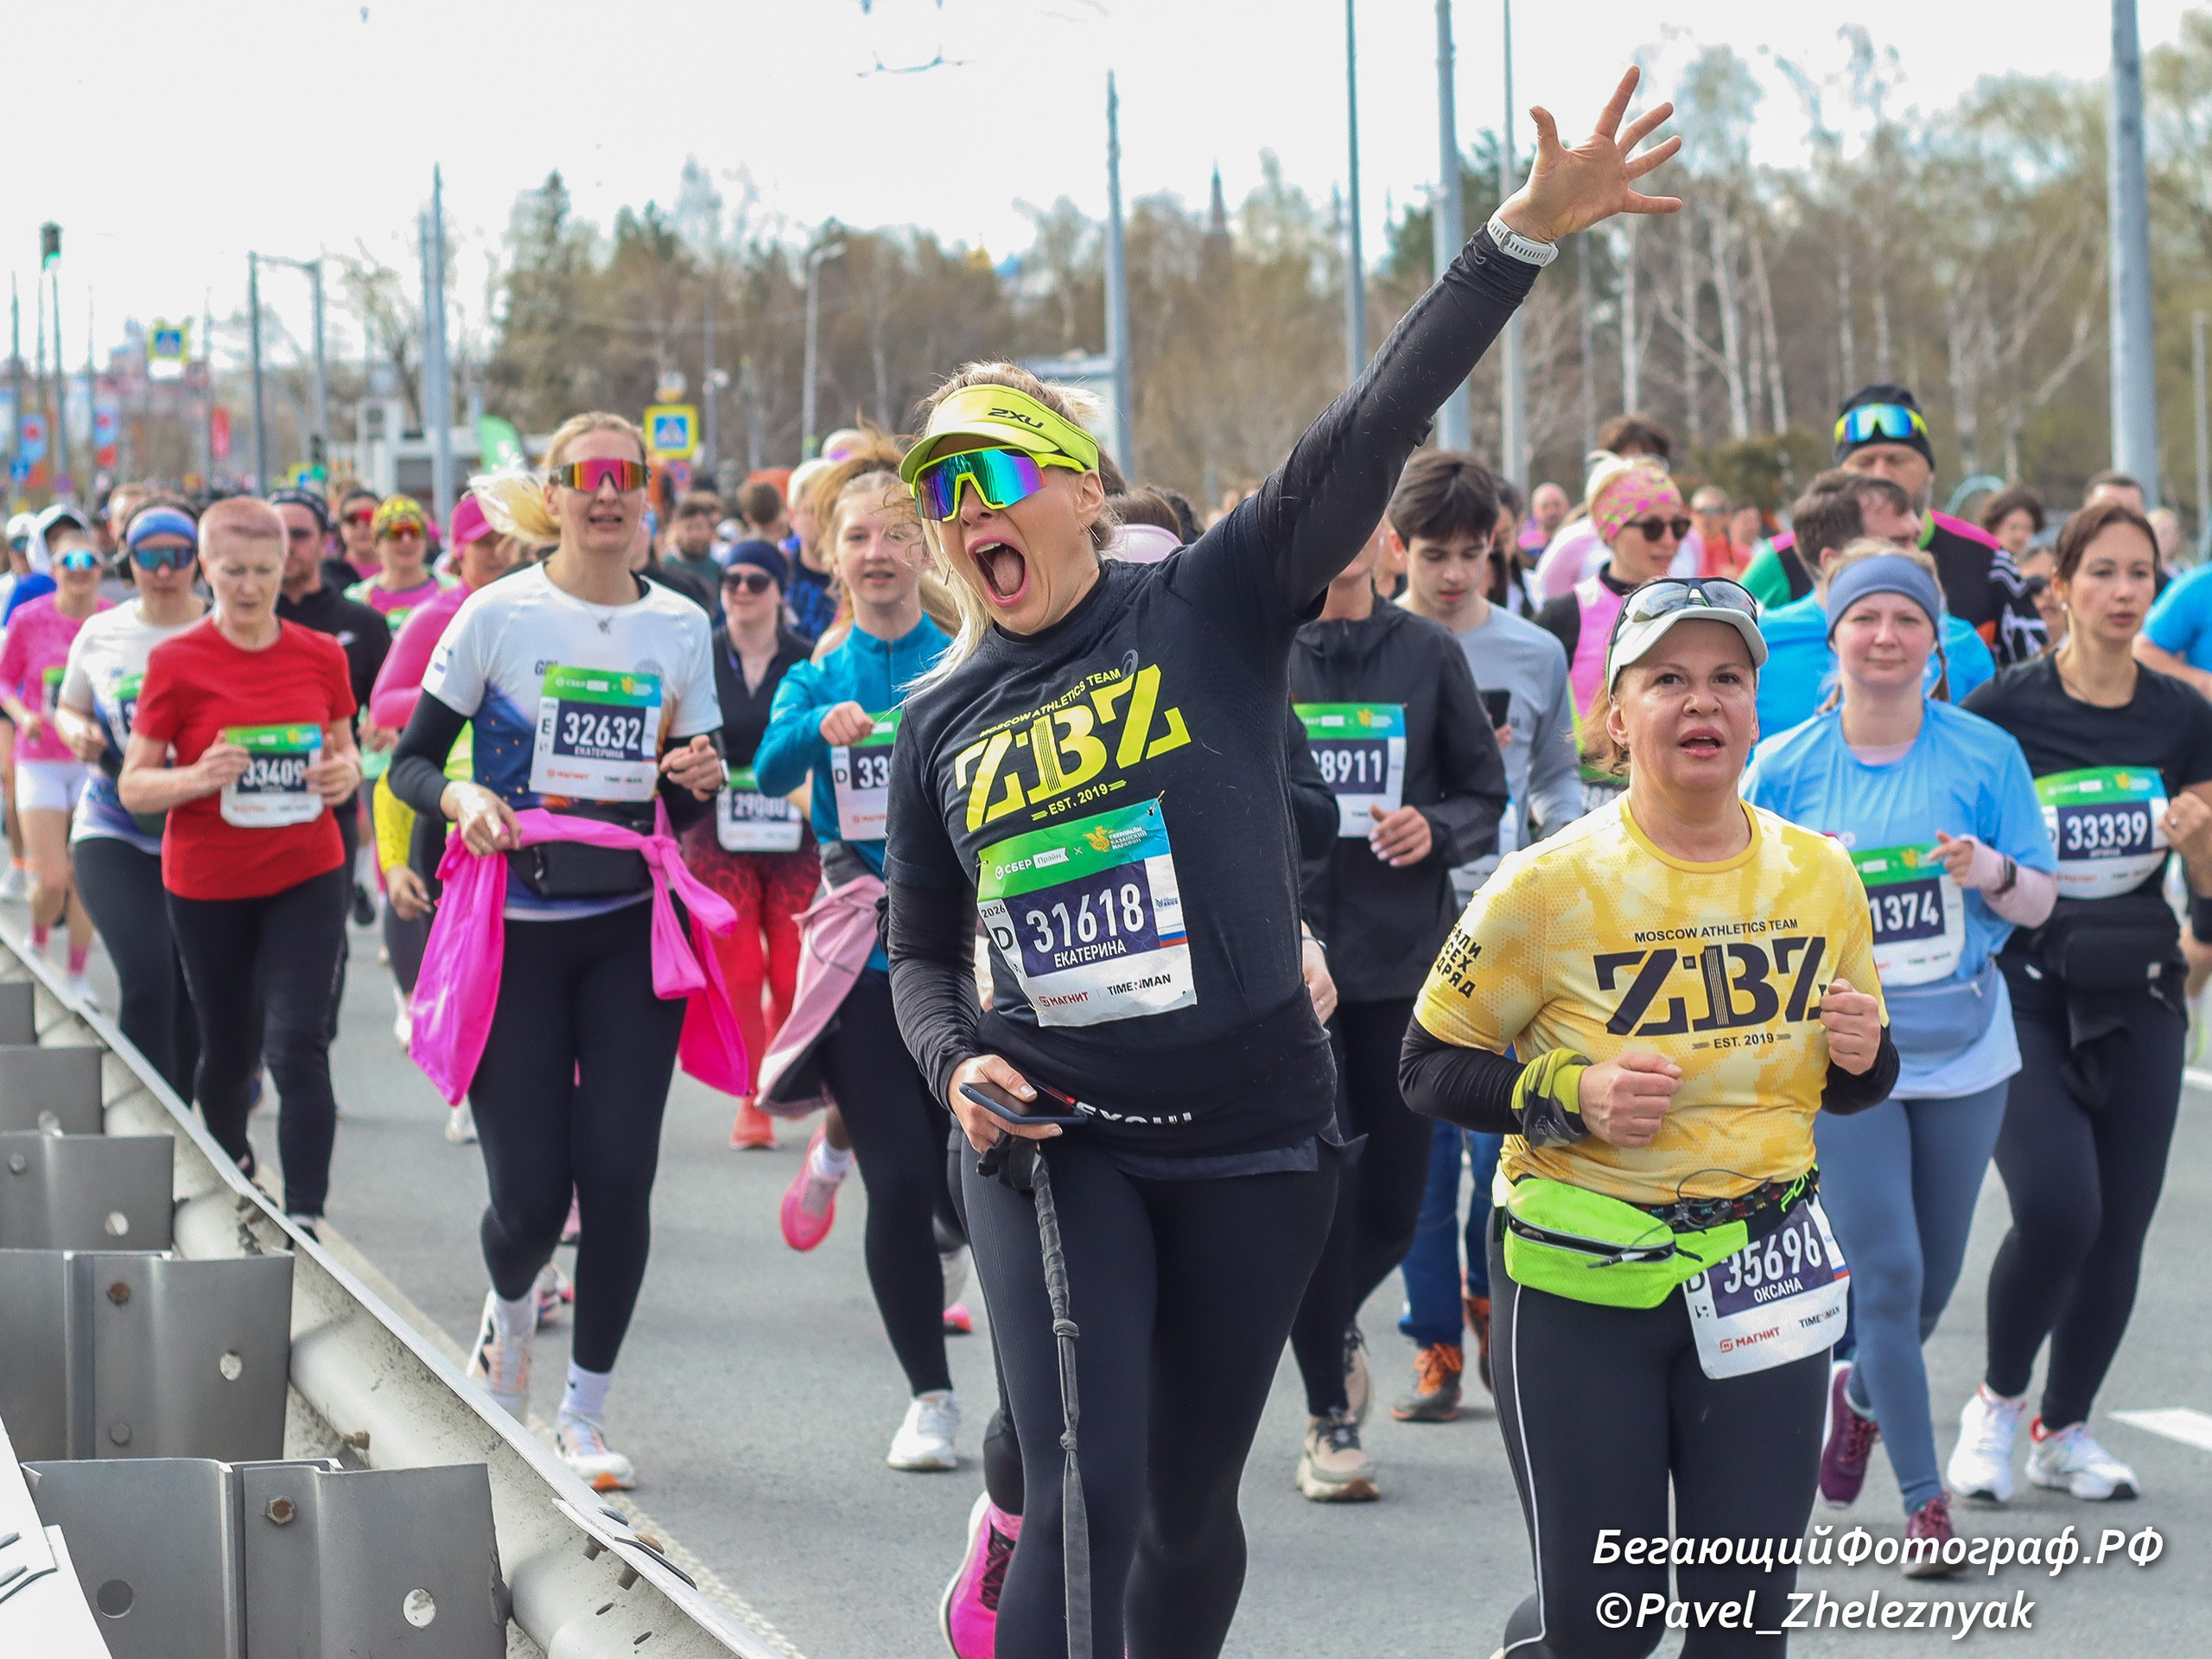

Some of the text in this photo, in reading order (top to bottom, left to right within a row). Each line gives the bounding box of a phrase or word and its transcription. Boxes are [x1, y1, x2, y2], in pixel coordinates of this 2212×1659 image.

[988, 407, 1044, 429] 2XU
[979, 668, 1122, 738] MOSCOW ATHLETICS TEAM
[563, 711, 641, 750] 32632
[834, 767, 848, 785] D
[857, 755, 891, 789] 33
[1311, 749, 1382, 784] 8911
[1048, 783, 1108, 817] EST. 2019
[2066, 811, 2148, 851] 33339
[1004, 853, 1062, 874] СБЕР Прайм
[981, 904, 1006, 918] 2026
[1026, 883, 1145, 954] 31618
[1870, 890, 1940, 933] 1374
[994, 925, 1014, 950] D
[1634, 918, 1798, 943] MOSCOW ATHLETICS TEAM
[1053, 938, 1127, 969] ЕКАТЕРИНА
[1445, 942, 1474, 973] СЕХ
[1049, 991, 1089, 1007] МАГНИТ
[1714, 1033, 1775, 1049] EST. 2019
[1720, 1222, 1822, 1294] 35696
[1753, 1276, 1803, 1303] ОКСАНА
[1735, 1325, 1780, 1348] МАГНИТ
